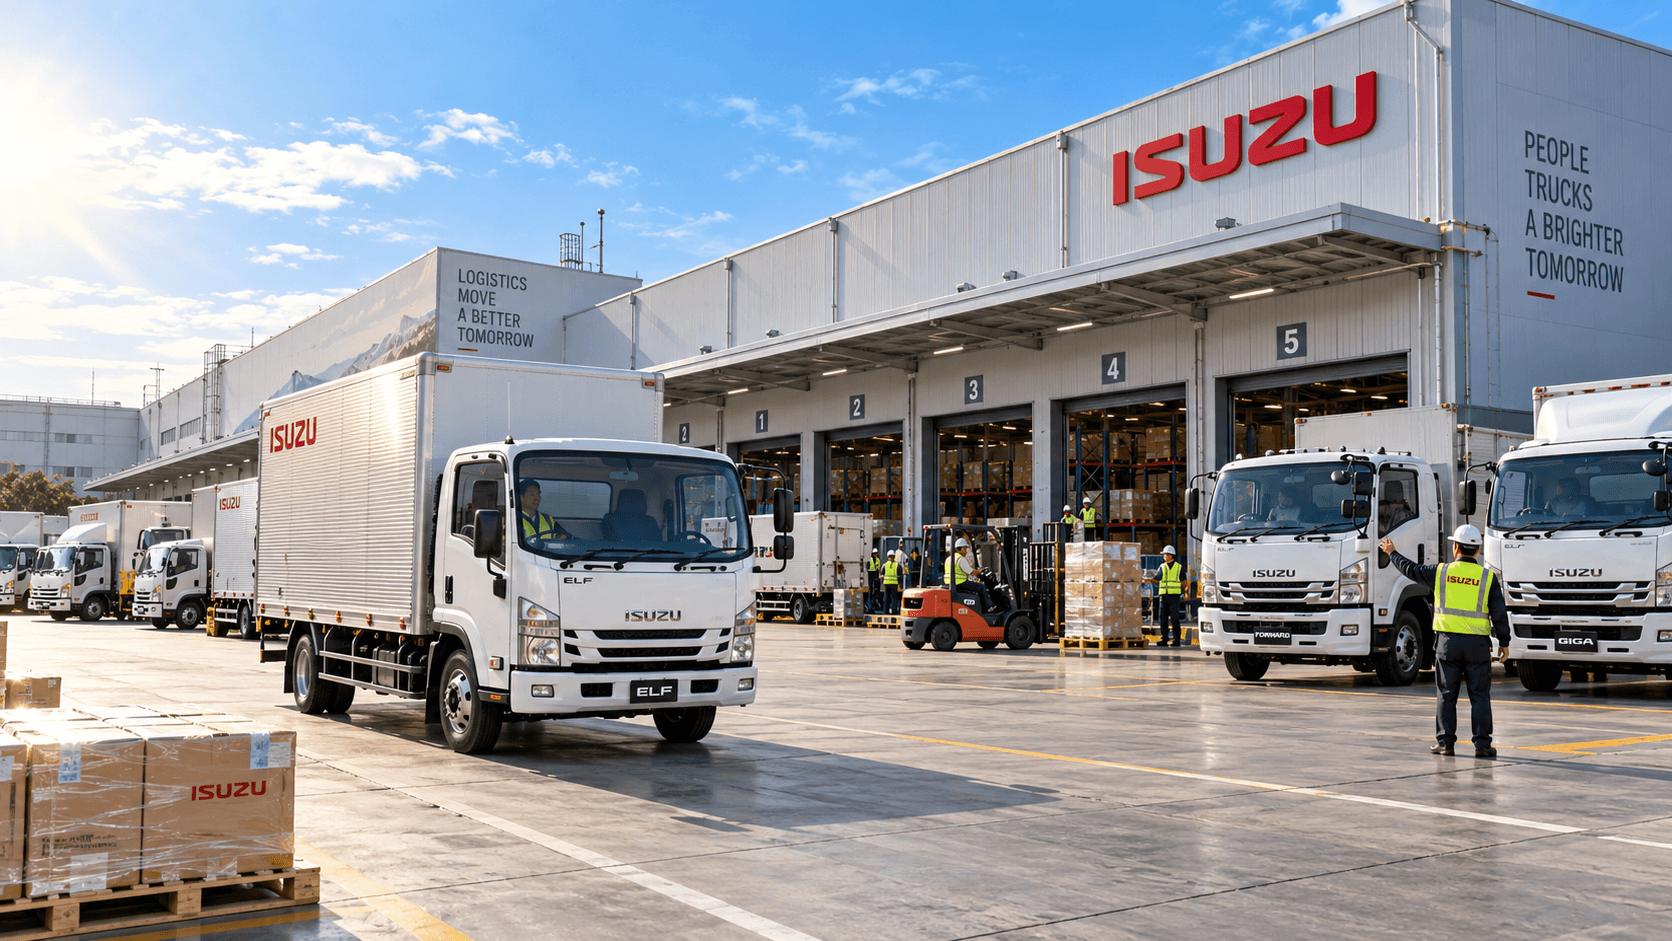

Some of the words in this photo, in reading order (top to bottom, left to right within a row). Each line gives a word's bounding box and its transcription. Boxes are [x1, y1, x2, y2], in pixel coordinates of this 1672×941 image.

[1112, 71, 1379, 206] ISUZU
[1525, 130, 1590, 174] PEOPLE
[1525, 168, 1593, 212] TRUCKS
[1525, 208, 1538, 238] A
[1543, 212, 1624, 257] BRIGHTER
[458, 268, 528, 292] LOGISTICS
[1525, 248, 1624, 293] TOMORROW
[458, 289, 496, 307] MOVE
[458, 308, 467, 324] A
[472, 310, 521, 329] BETTER
[457, 327, 535, 348] TOMORROW
[1284, 328, 1299, 354] 5
[1107, 357, 1120, 380] 4
[969, 379, 979, 400] 3
[853, 398, 861, 417] 2
[759, 413, 764, 430] 1
[270, 416, 317, 454] ISUZU
[682, 426, 687, 442] 2
[219, 496, 241, 511] ISUZU
[1252, 569, 1296, 578] ISUZU
[1446, 575, 1480, 587] ISUZU
[1549, 568, 1603, 578] ISUZU
[624, 610, 682, 622] ISUZU
[1557, 637, 1594, 646] GIGA
[636, 685, 673, 697] ELF
[191, 780, 267, 801] ISUZU
